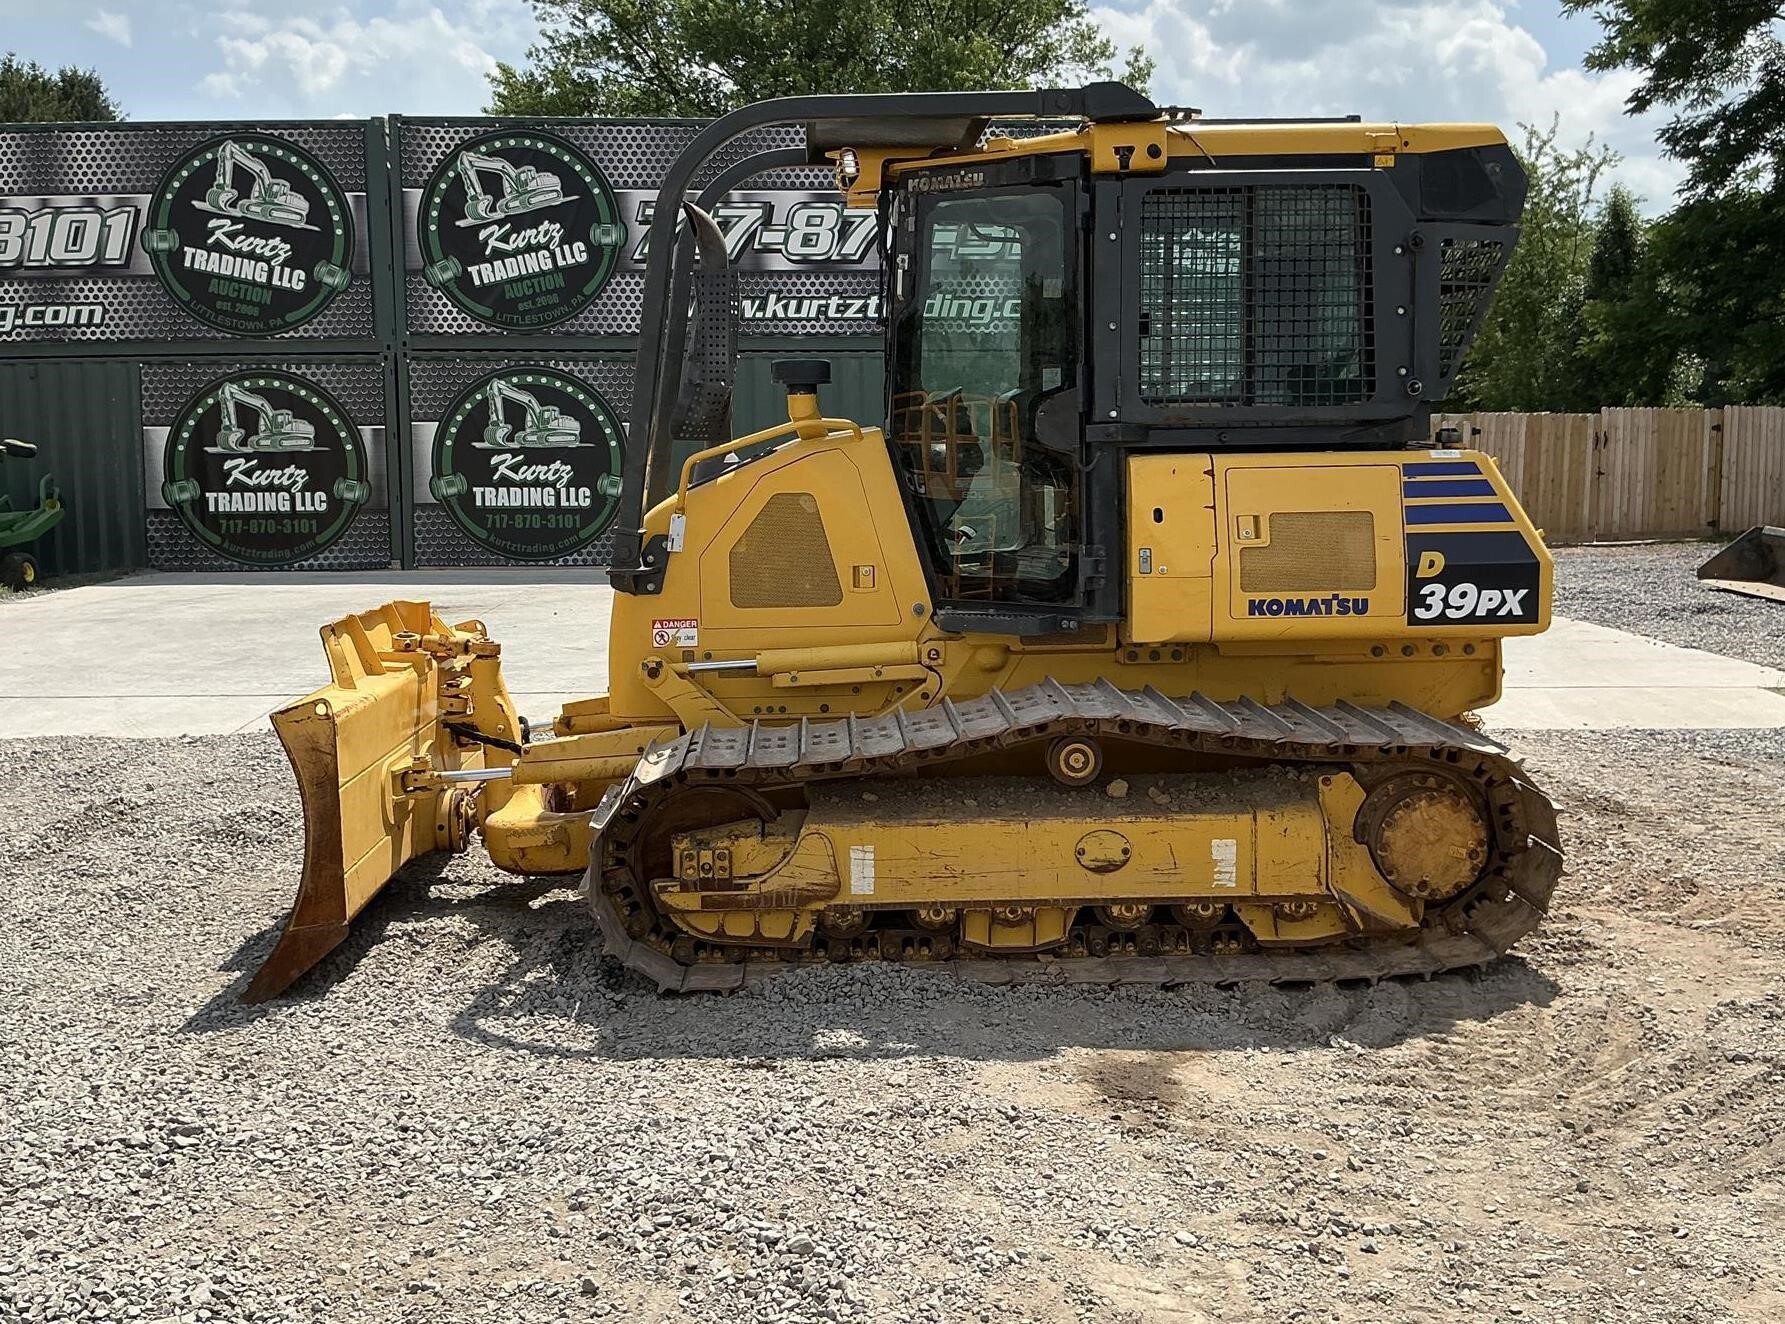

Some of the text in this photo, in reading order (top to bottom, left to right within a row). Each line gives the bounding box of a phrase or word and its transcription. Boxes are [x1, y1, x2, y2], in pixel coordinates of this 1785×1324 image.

[907, 170, 985, 192] KOMATSU
[207, 217, 293, 266] Kurtz
[478, 219, 565, 256] Kurtz
[183, 246, 306, 290] TRADING LLC
[467, 241, 588, 286] TRADING LLC
[207, 278, 272, 305] AUCTION
[504, 272, 566, 299] AUCTION
[571, 294, 585, 306] PA
[223, 457, 309, 492] Kurtz
[490, 453, 574, 487] Kurtz
[205, 491, 327, 512] TRADING LLC
[473, 487, 591, 506] TRADING LLC
[219, 519, 317, 534] 717-870-3101
[485, 514, 581, 528] 717-870-3101
[223, 540, 315, 559] kurtztrading.com
[488, 534, 579, 553] kurtztrading.com
[1416, 551, 1445, 578] D
[1248, 593, 1369, 616] KOMATSU
[1414, 583, 1529, 619] 39PX
[663, 620, 697, 628] DANGER
